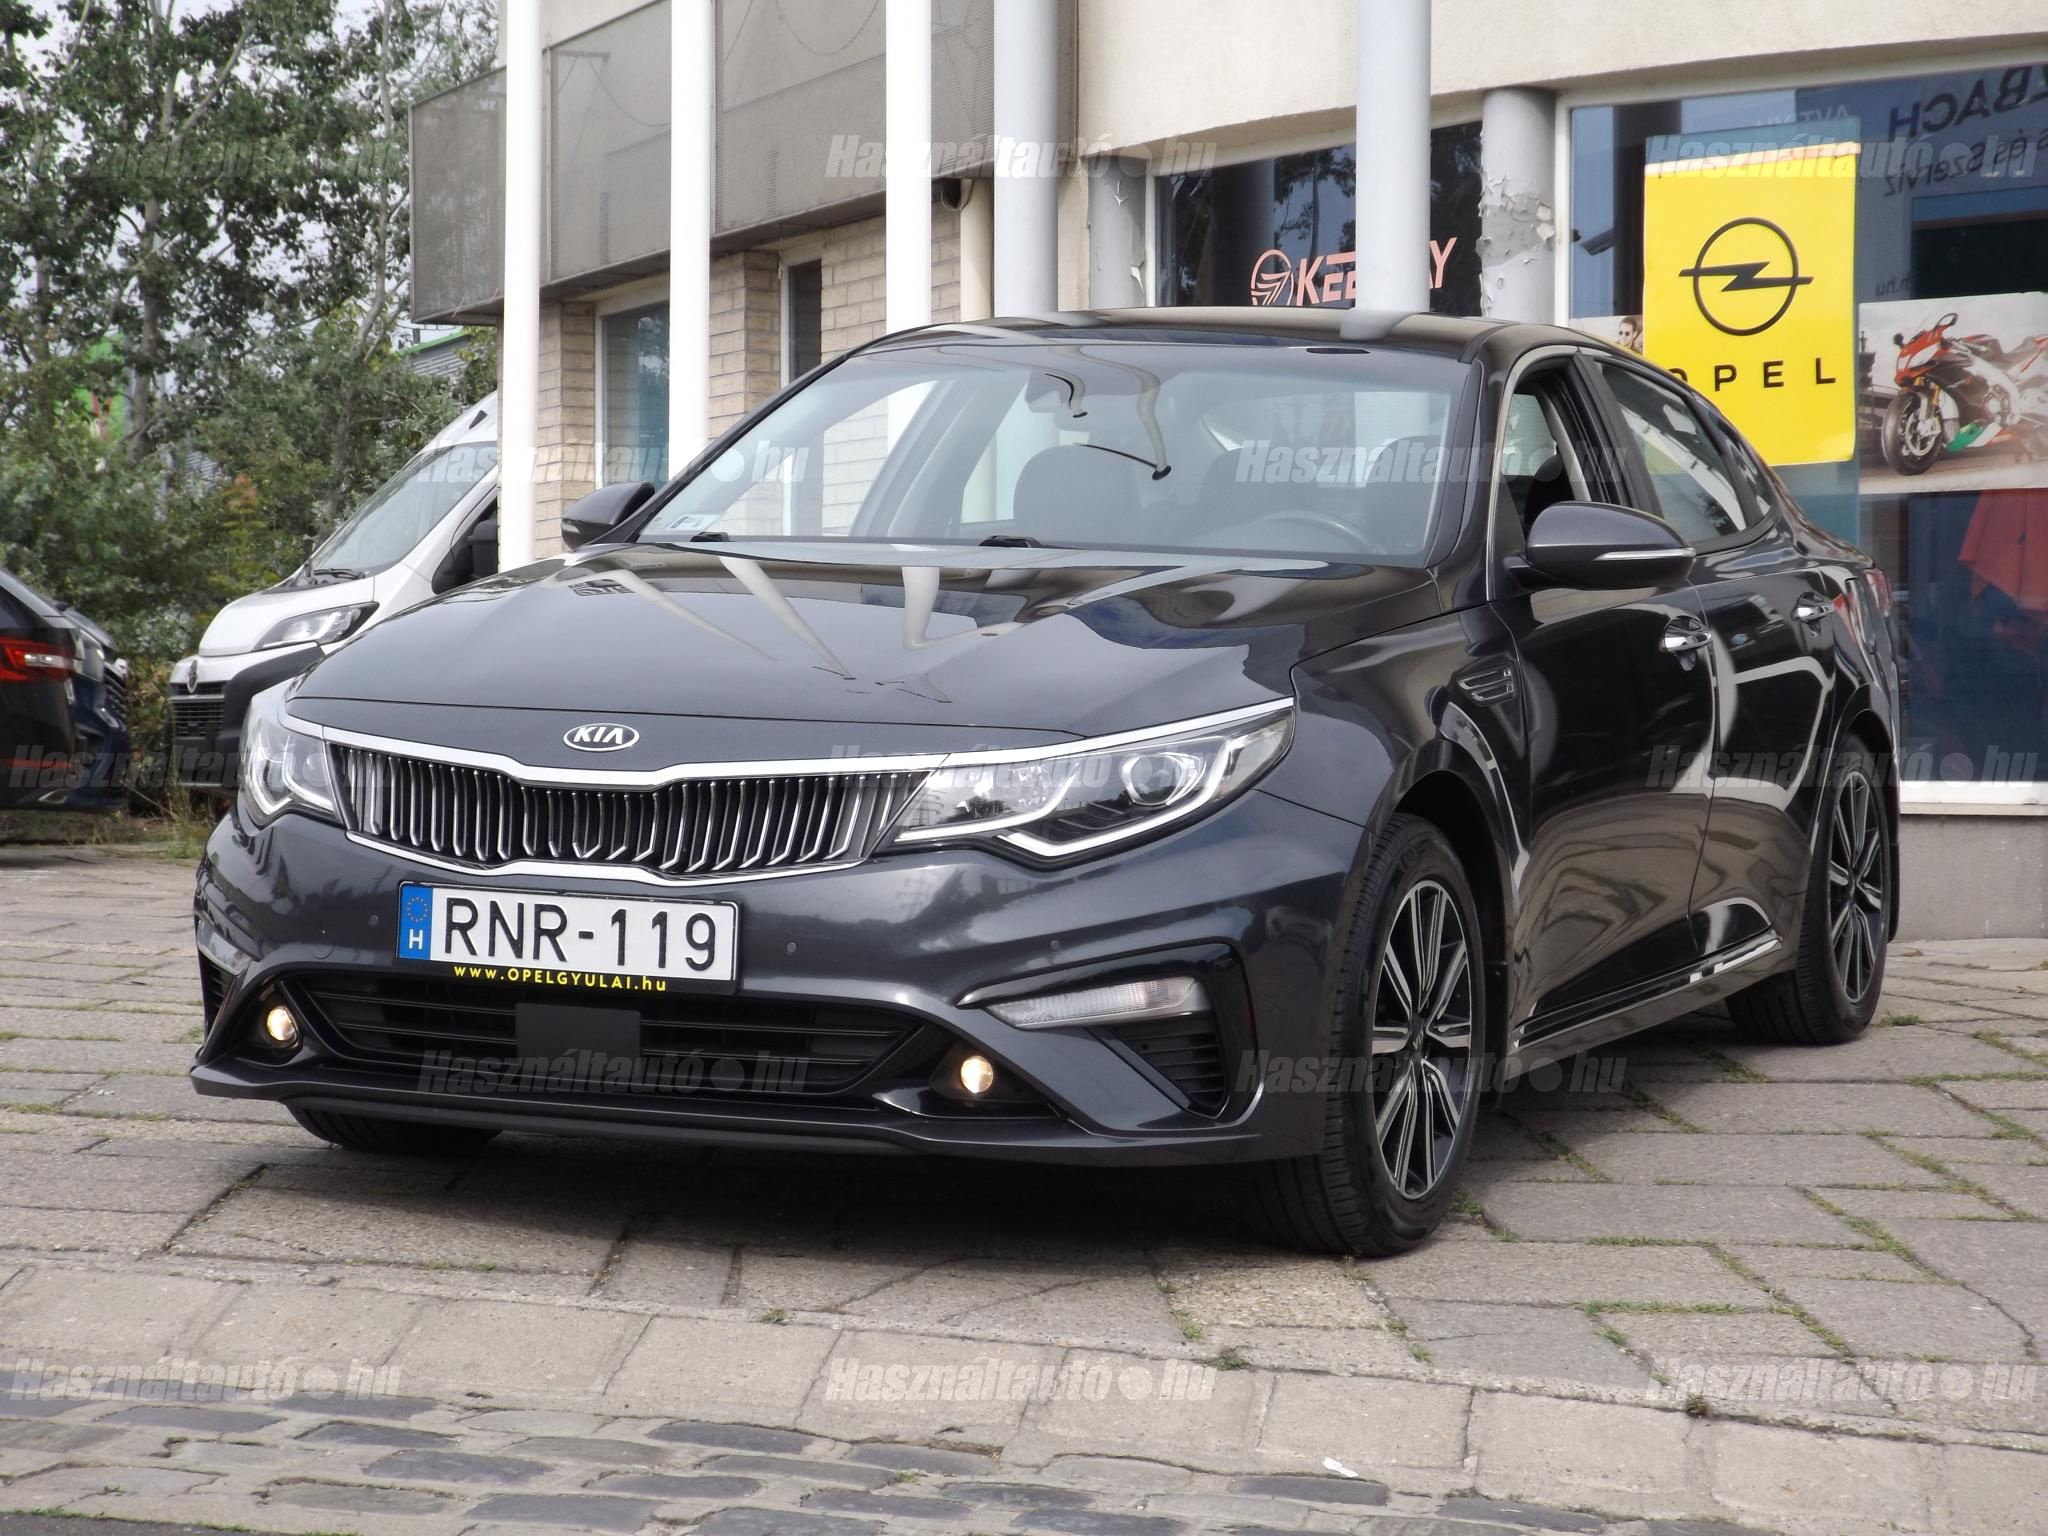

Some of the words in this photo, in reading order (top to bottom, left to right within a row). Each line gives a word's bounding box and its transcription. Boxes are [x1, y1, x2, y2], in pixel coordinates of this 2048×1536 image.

[573, 726, 623, 745] KIA
[408, 929, 423, 951] H
[445, 897, 716, 972] RNR-119
[454, 966, 666, 991] www.OPELGYULAI.hu
